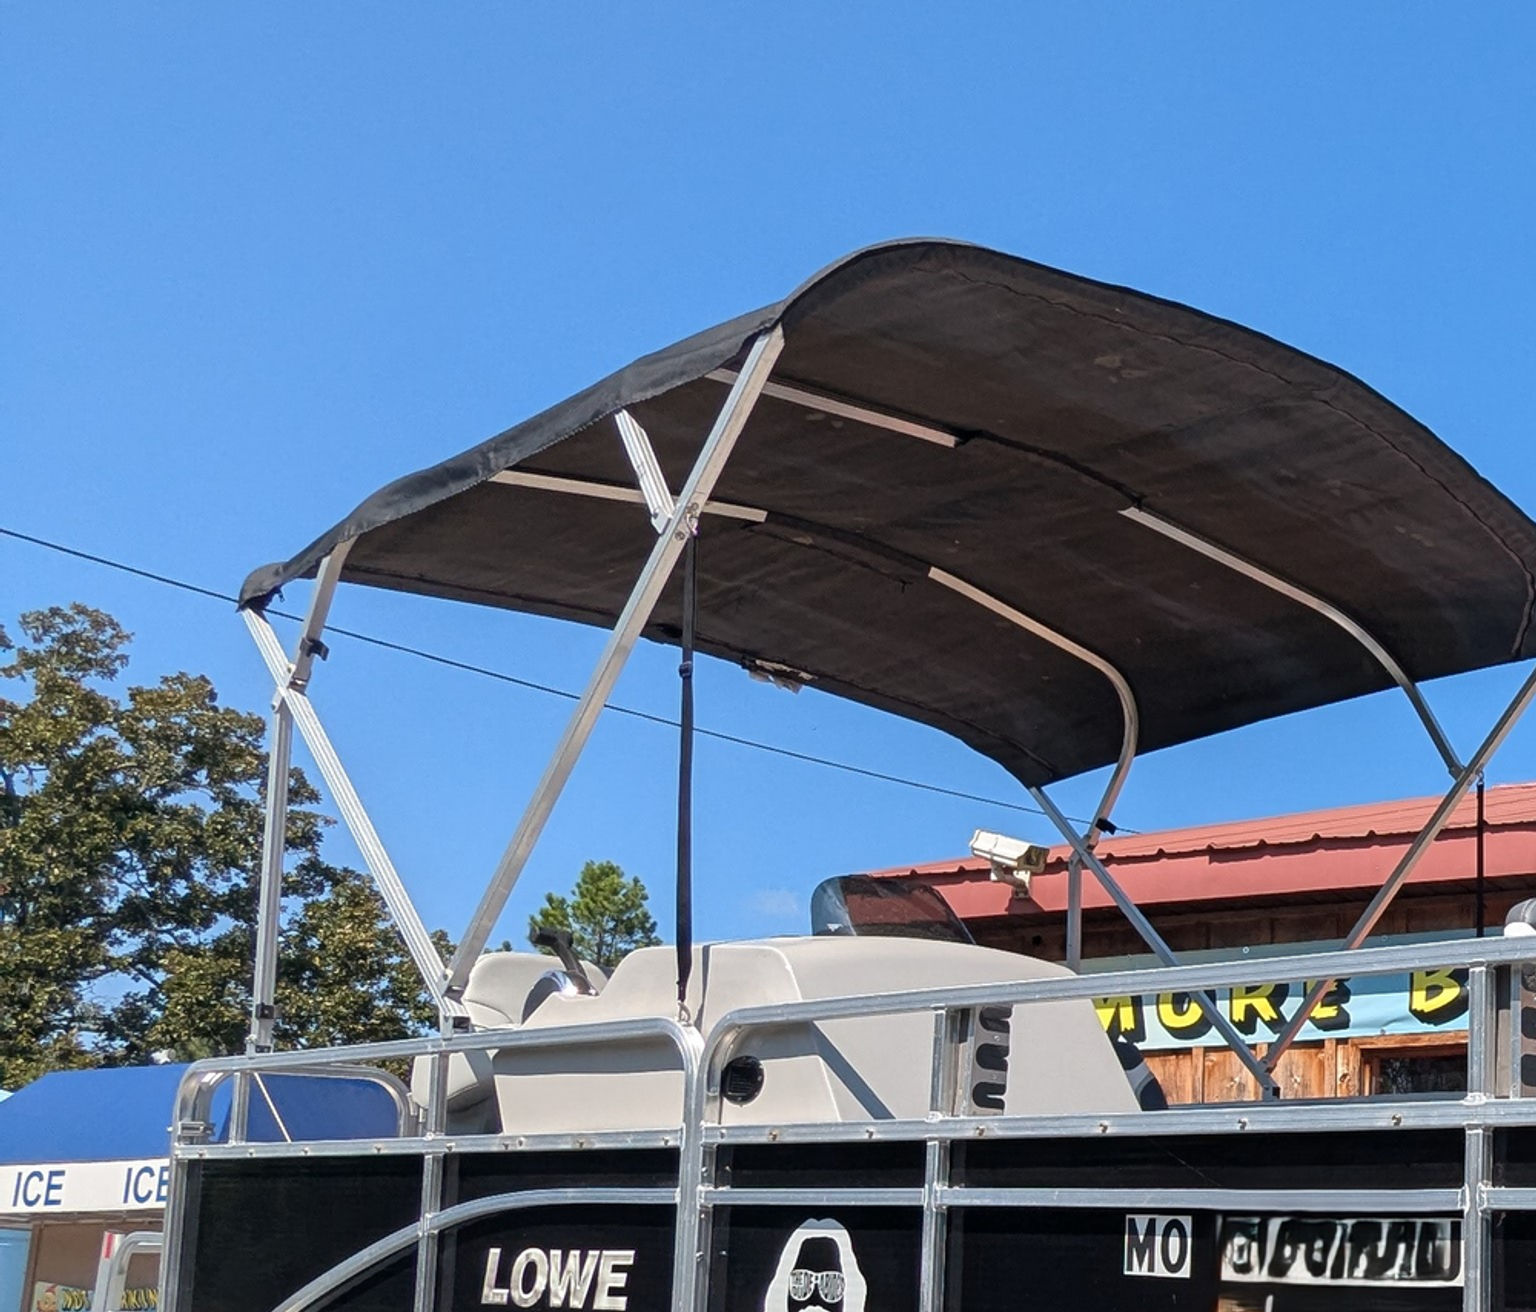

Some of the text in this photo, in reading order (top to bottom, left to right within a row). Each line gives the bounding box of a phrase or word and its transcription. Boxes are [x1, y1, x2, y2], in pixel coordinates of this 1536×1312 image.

[12, 1170, 66, 1208] ICE
[1126, 1217, 1188, 1274] MO
[480, 1247, 636, 1312] LOWE
